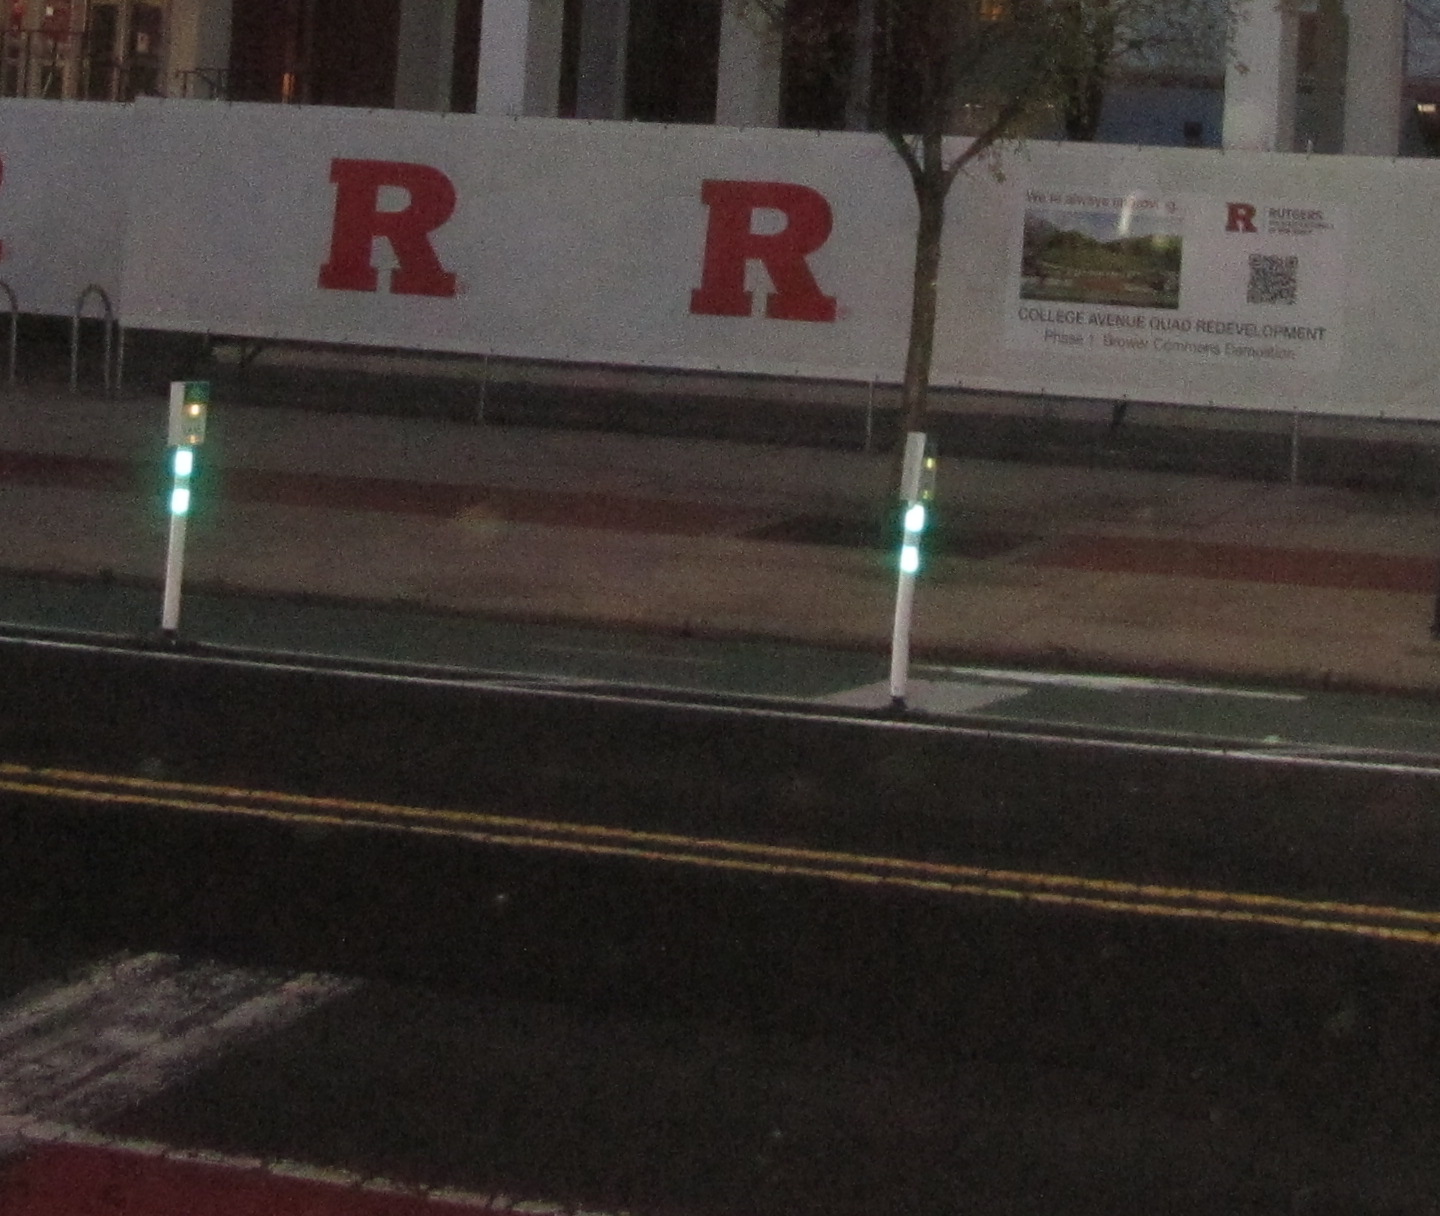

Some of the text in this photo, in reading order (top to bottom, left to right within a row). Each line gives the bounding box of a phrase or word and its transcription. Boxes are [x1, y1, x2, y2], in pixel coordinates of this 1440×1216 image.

[318, 158, 457, 298] R
[1225, 202, 1258, 233] R
[1268, 207, 1324, 220] RUTGERS
[689, 178, 837, 322] R
[1018, 307, 1327, 339] COLLEGE AVENUE QUAD REDEVELOPMENT
[1044, 328, 1084, 345] Phase
[1103, 333, 1148, 349] Brower
[1152, 337, 1221, 355] Commons
